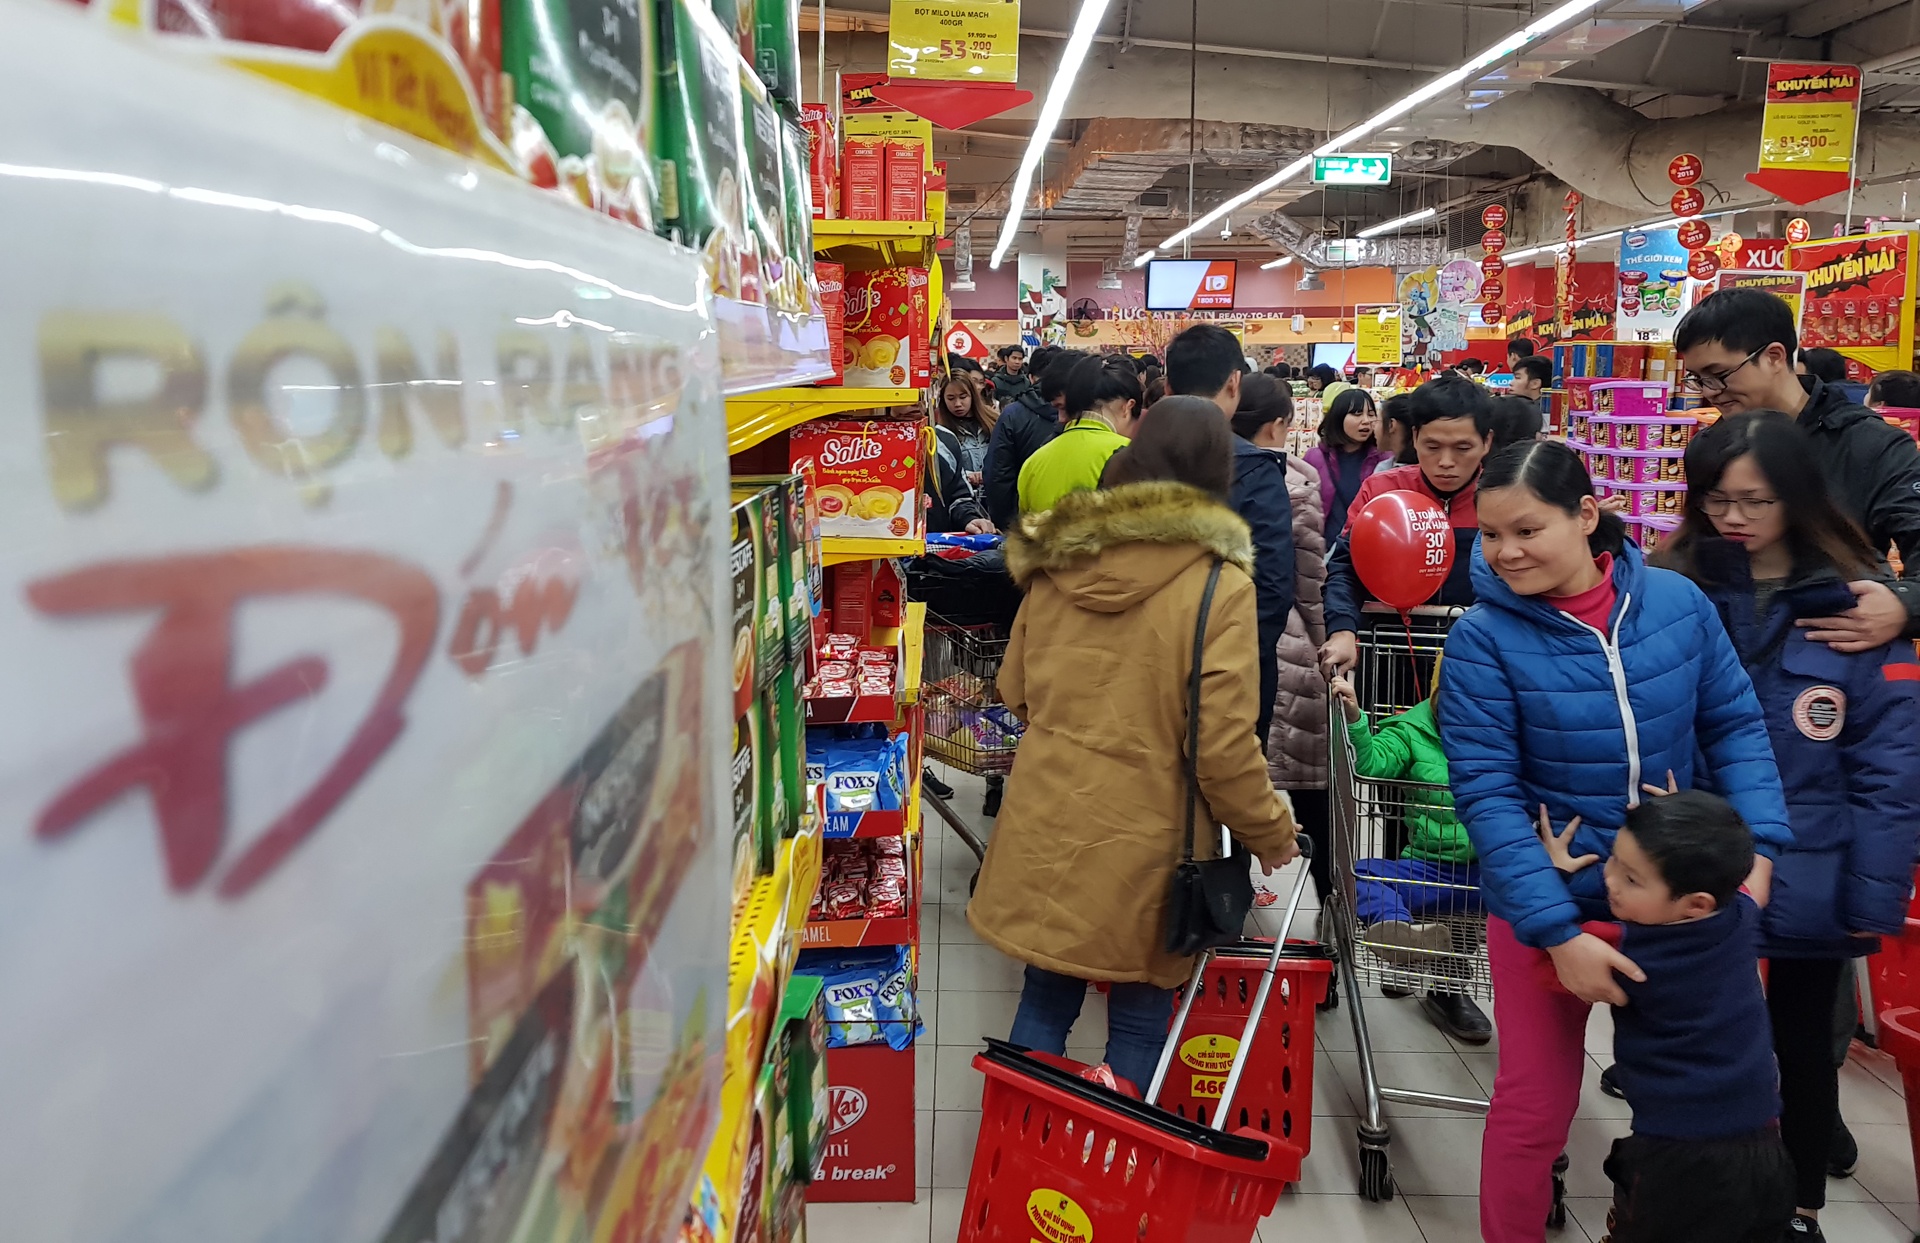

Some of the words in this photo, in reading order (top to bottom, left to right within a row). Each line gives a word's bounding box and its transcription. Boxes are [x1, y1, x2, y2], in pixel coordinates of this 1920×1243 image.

[914, 8, 929, 16] BỘT
[931, 9, 949, 17] MILO
[939, 19, 963, 27] 400GR
[1776, 75, 1828, 92] KHUYẾN
[800, 110, 823, 123] Solite
[1677, 170, 1694, 178] 2018
[1680, 201, 1697, 212] 2018
[1687, 233, 1704, 243] 2018
[1625, 253, 1644, 265] THẾ
[1664, 256, 1683, 265] KEM
[1697, 264, 1714, 274] 2018
[1806, 253, 1863, 289] KHUYẾN
[818, 280, 842, 294] Solite
[1735, 275, 1775, 288] KHUYẾN
[1219, 311, 1284, 320] READY-TO-EAT
[1637, 331, 1650, 341] 18
[38, 283, 464, 510] RỘN
[820, 437, 882, 467] Solite
[834, 775, 875, 789] FOX'S
[832, 983, 874, 1002] FOX'S
[1185, 1053, 1205, 1068] TRONG
[1205, 1061, 1218, 1069] KHU
[1030, 1204, 1047, 1230] TRONG
[1046, 1225, 1060, 1239] KHU
